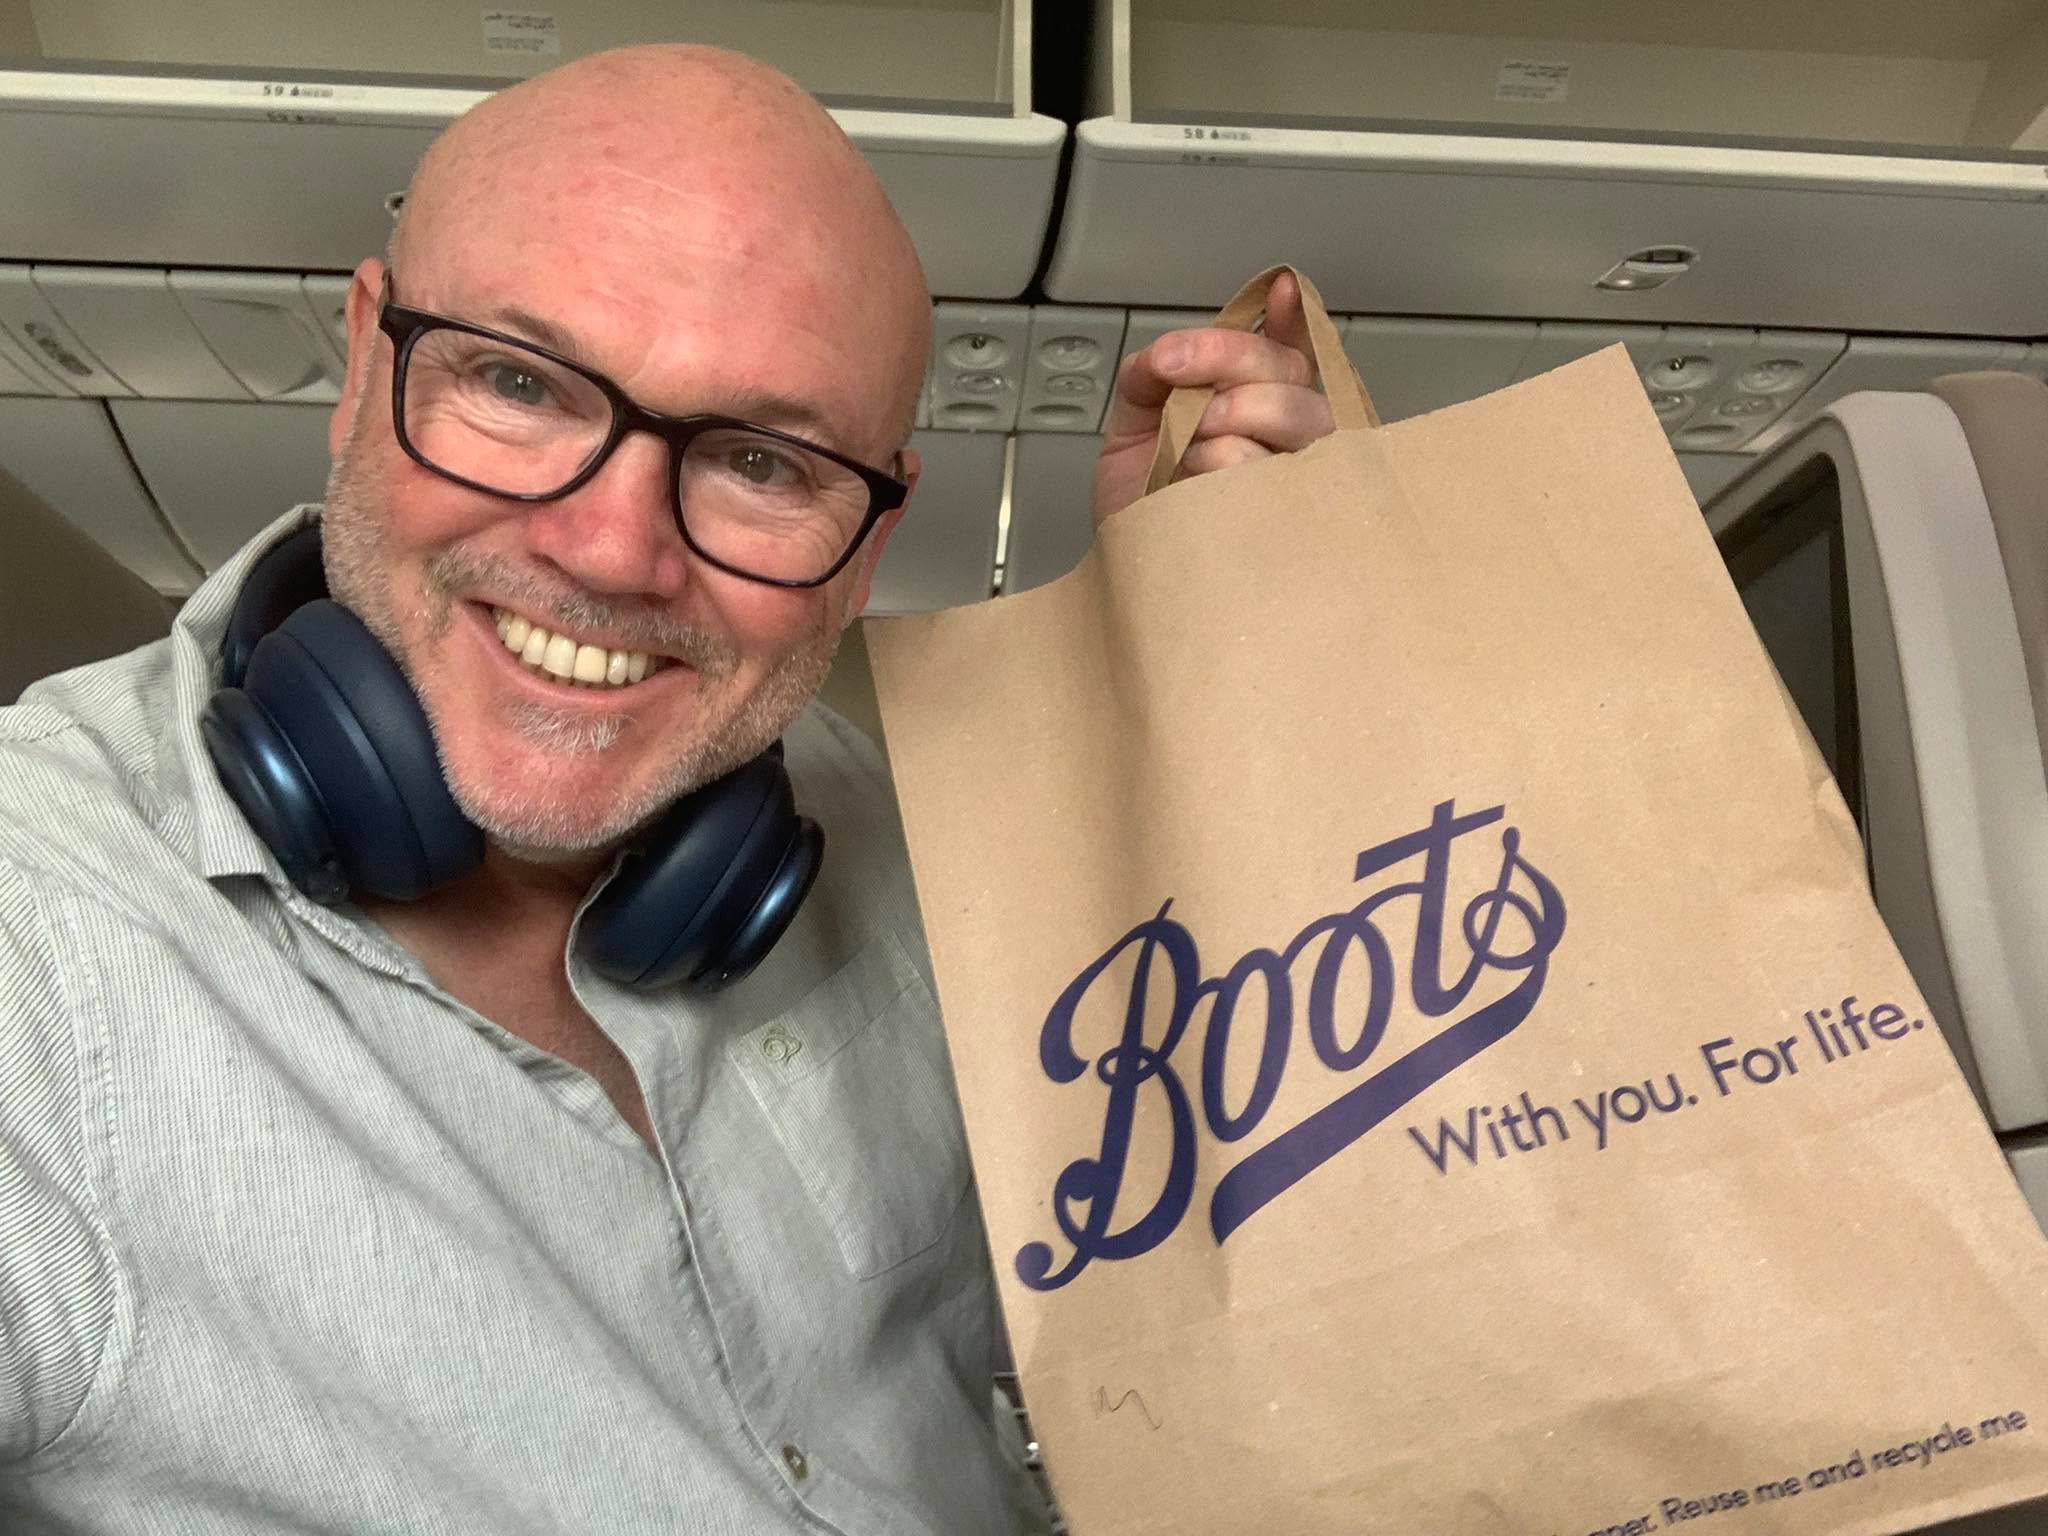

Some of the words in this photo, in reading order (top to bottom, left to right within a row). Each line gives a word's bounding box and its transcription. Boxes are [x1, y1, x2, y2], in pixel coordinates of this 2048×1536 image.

[1015, 798, 1567, 1292] Boots
[1408, 1090, 1569, 1176] With
[1574, 1073, 1699, 1150] you.
[1700, 1036, 1799, 1097] For
[1804, 996, 1924, 1063] life.
[1660, 1488, 1751, 1526] Reuse
[1754, 1476, 1802, 1503] me
[1806, 1448, 1867, 1490] and
[1870, 1421, 1976, 1468] recycle
[1979, 1409, 2028, 1441] me
